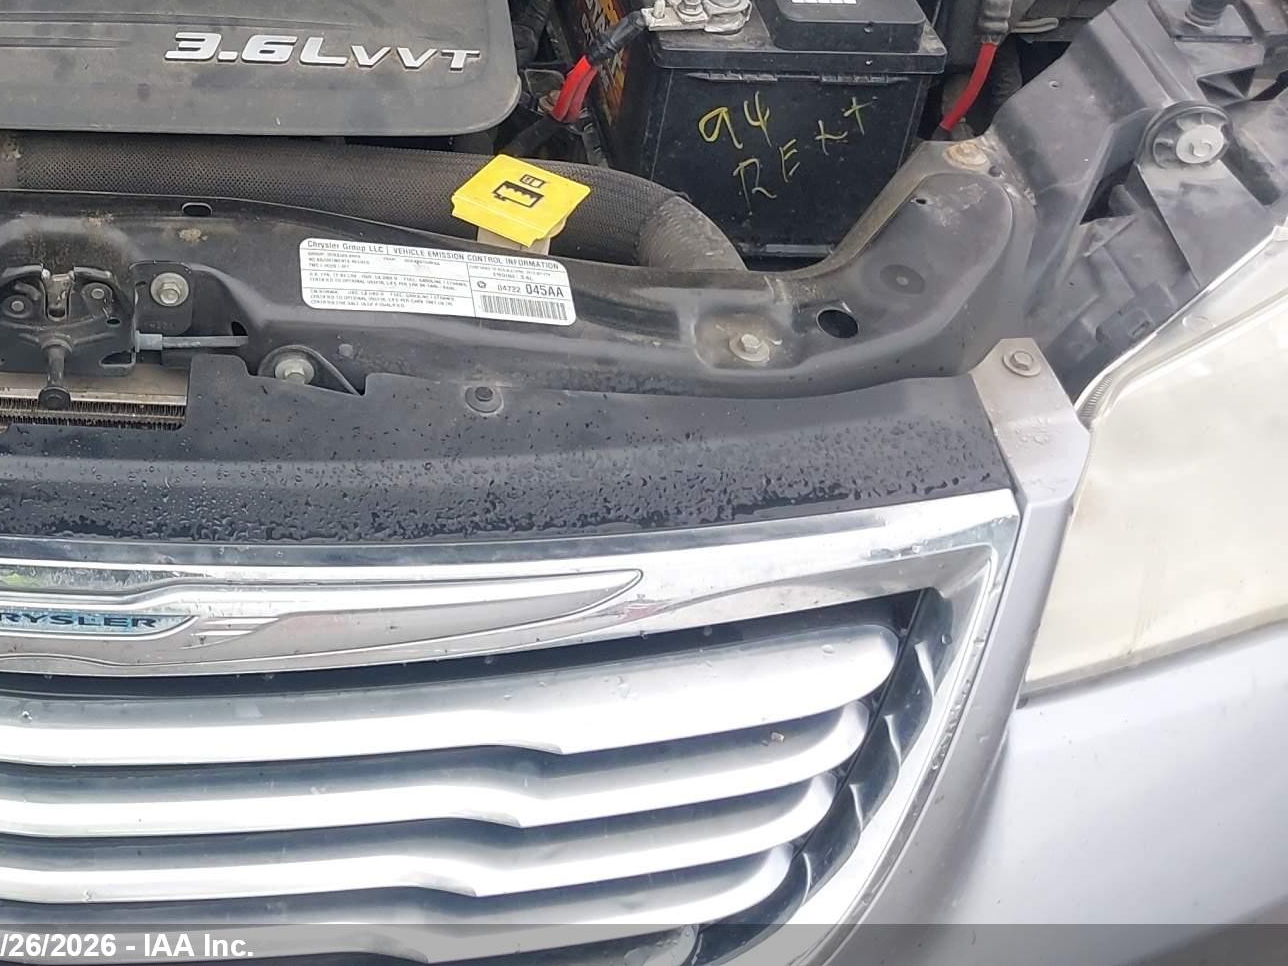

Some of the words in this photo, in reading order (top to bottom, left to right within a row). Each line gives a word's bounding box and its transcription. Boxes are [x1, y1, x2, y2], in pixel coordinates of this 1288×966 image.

[164, 32, 349, 68] 3.6L
[350, 44, 481, 72] VVT
[307, 240, 340, 249] Chrysler
[342, 243, 366, 253] Group
[368, 245, 384, 253] LLC
[393, 247, 424, 257] VEHICLE
[427, 250, 465, 260] EMISSION
[467, 254, 502, 264] CONTROL
[505, 258, 559, 270] INFORMATION
[525, 283, 565, 298] 045AA
